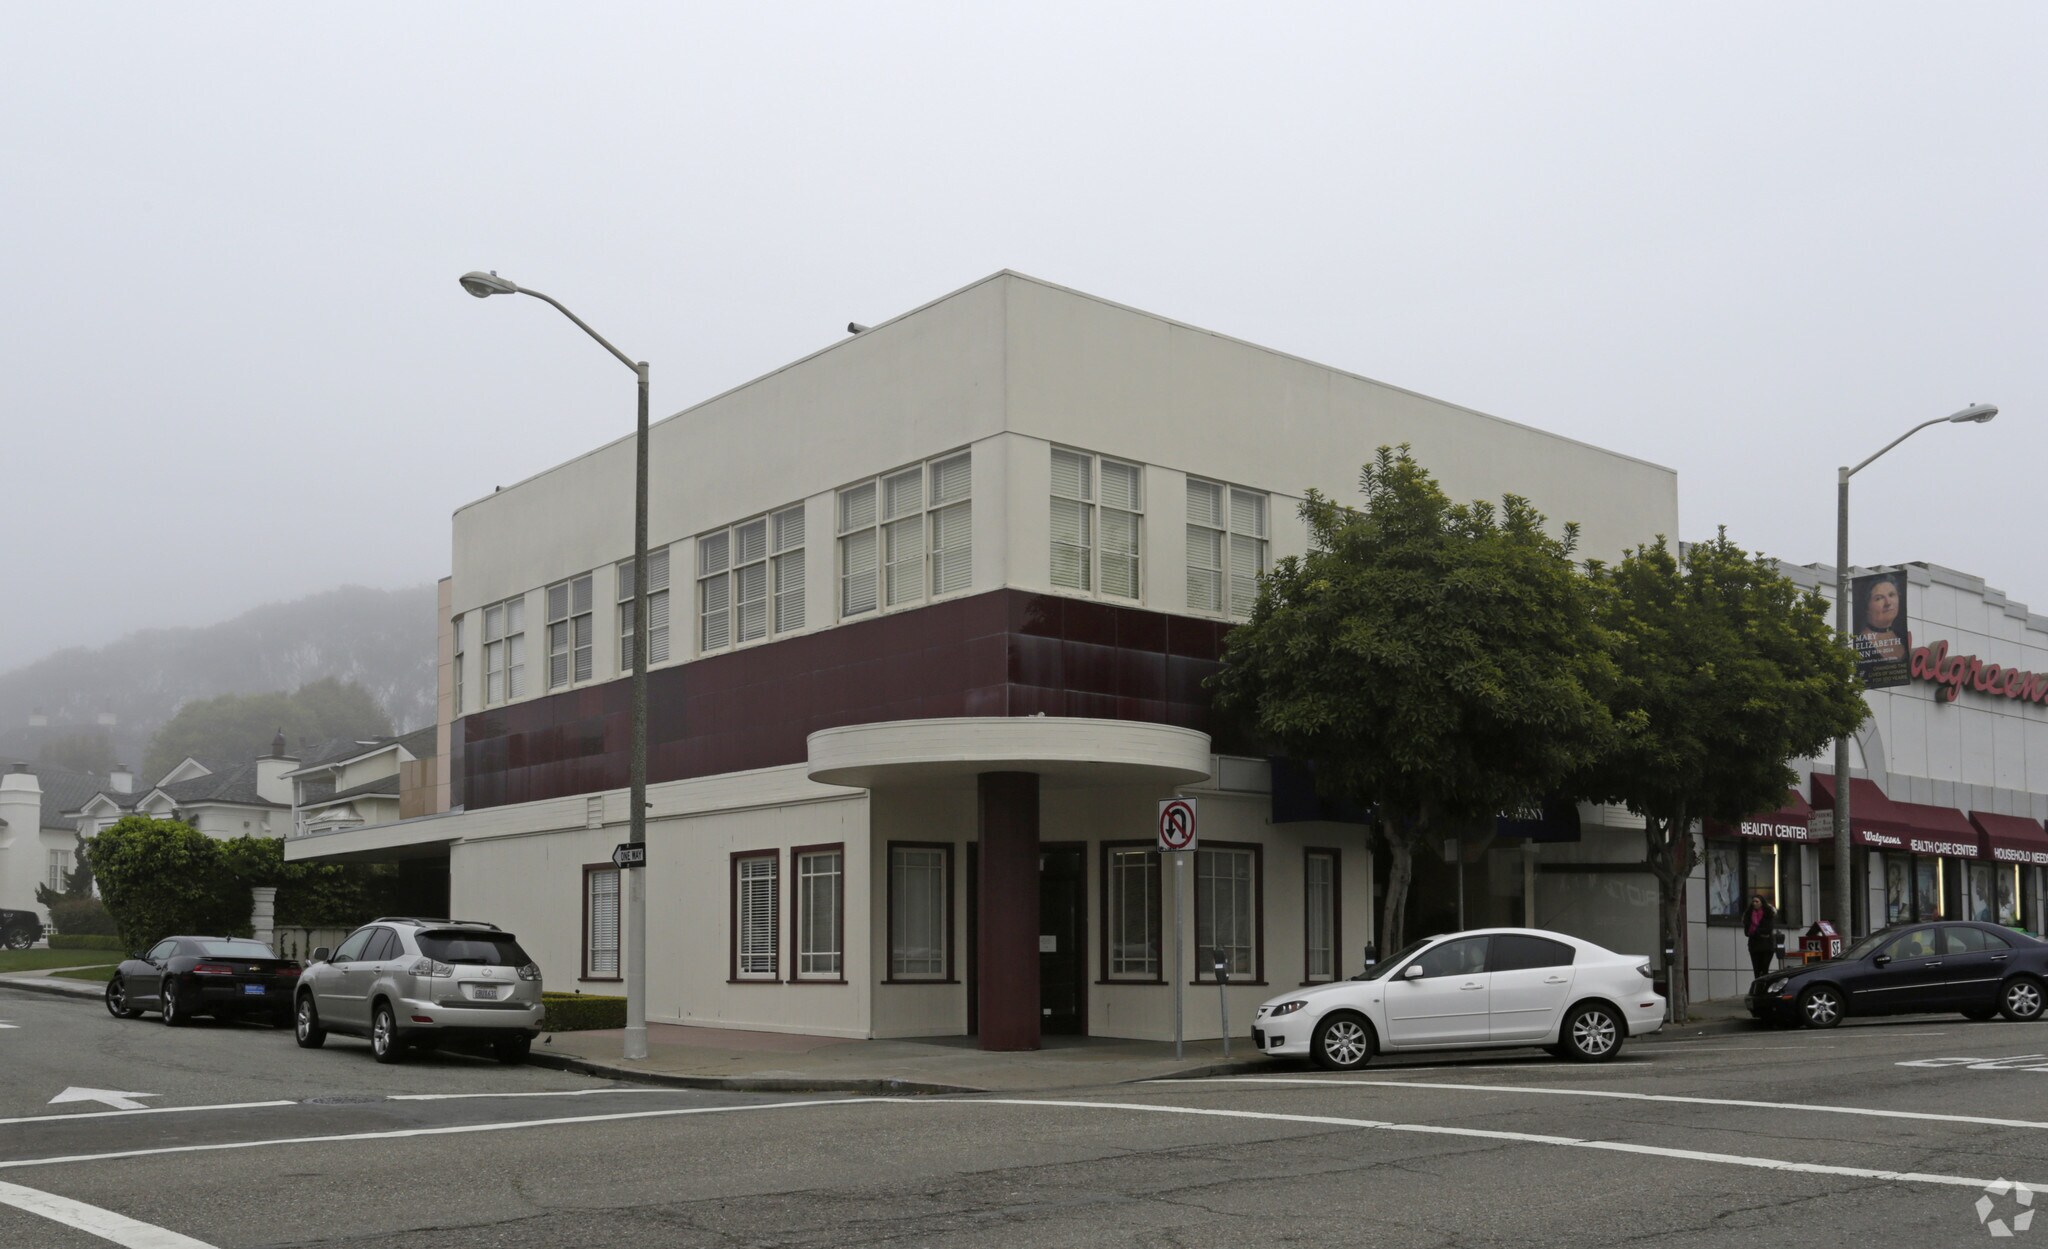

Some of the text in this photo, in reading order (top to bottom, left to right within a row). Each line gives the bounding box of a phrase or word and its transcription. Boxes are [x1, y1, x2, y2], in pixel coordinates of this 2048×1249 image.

[1855, 638, 1902, 650] ELIZABETH
[1856, 633, 1878, 641] MARY
[1908, 631, 2048, 705] algreen
[1741, 822, 1773, 836] BEAUTY
[1775, 825, 1807, 839] CENTER
[1863, 831, 1901, 845] Walgreens
[621, 850, 642, 861] ONE WAY
[1935, 842, 1952, 854] CARE
[1952, 844, 1978, 856] CENTER
[1994, 847, 2048, 863] HOUSEHOLD NEED
